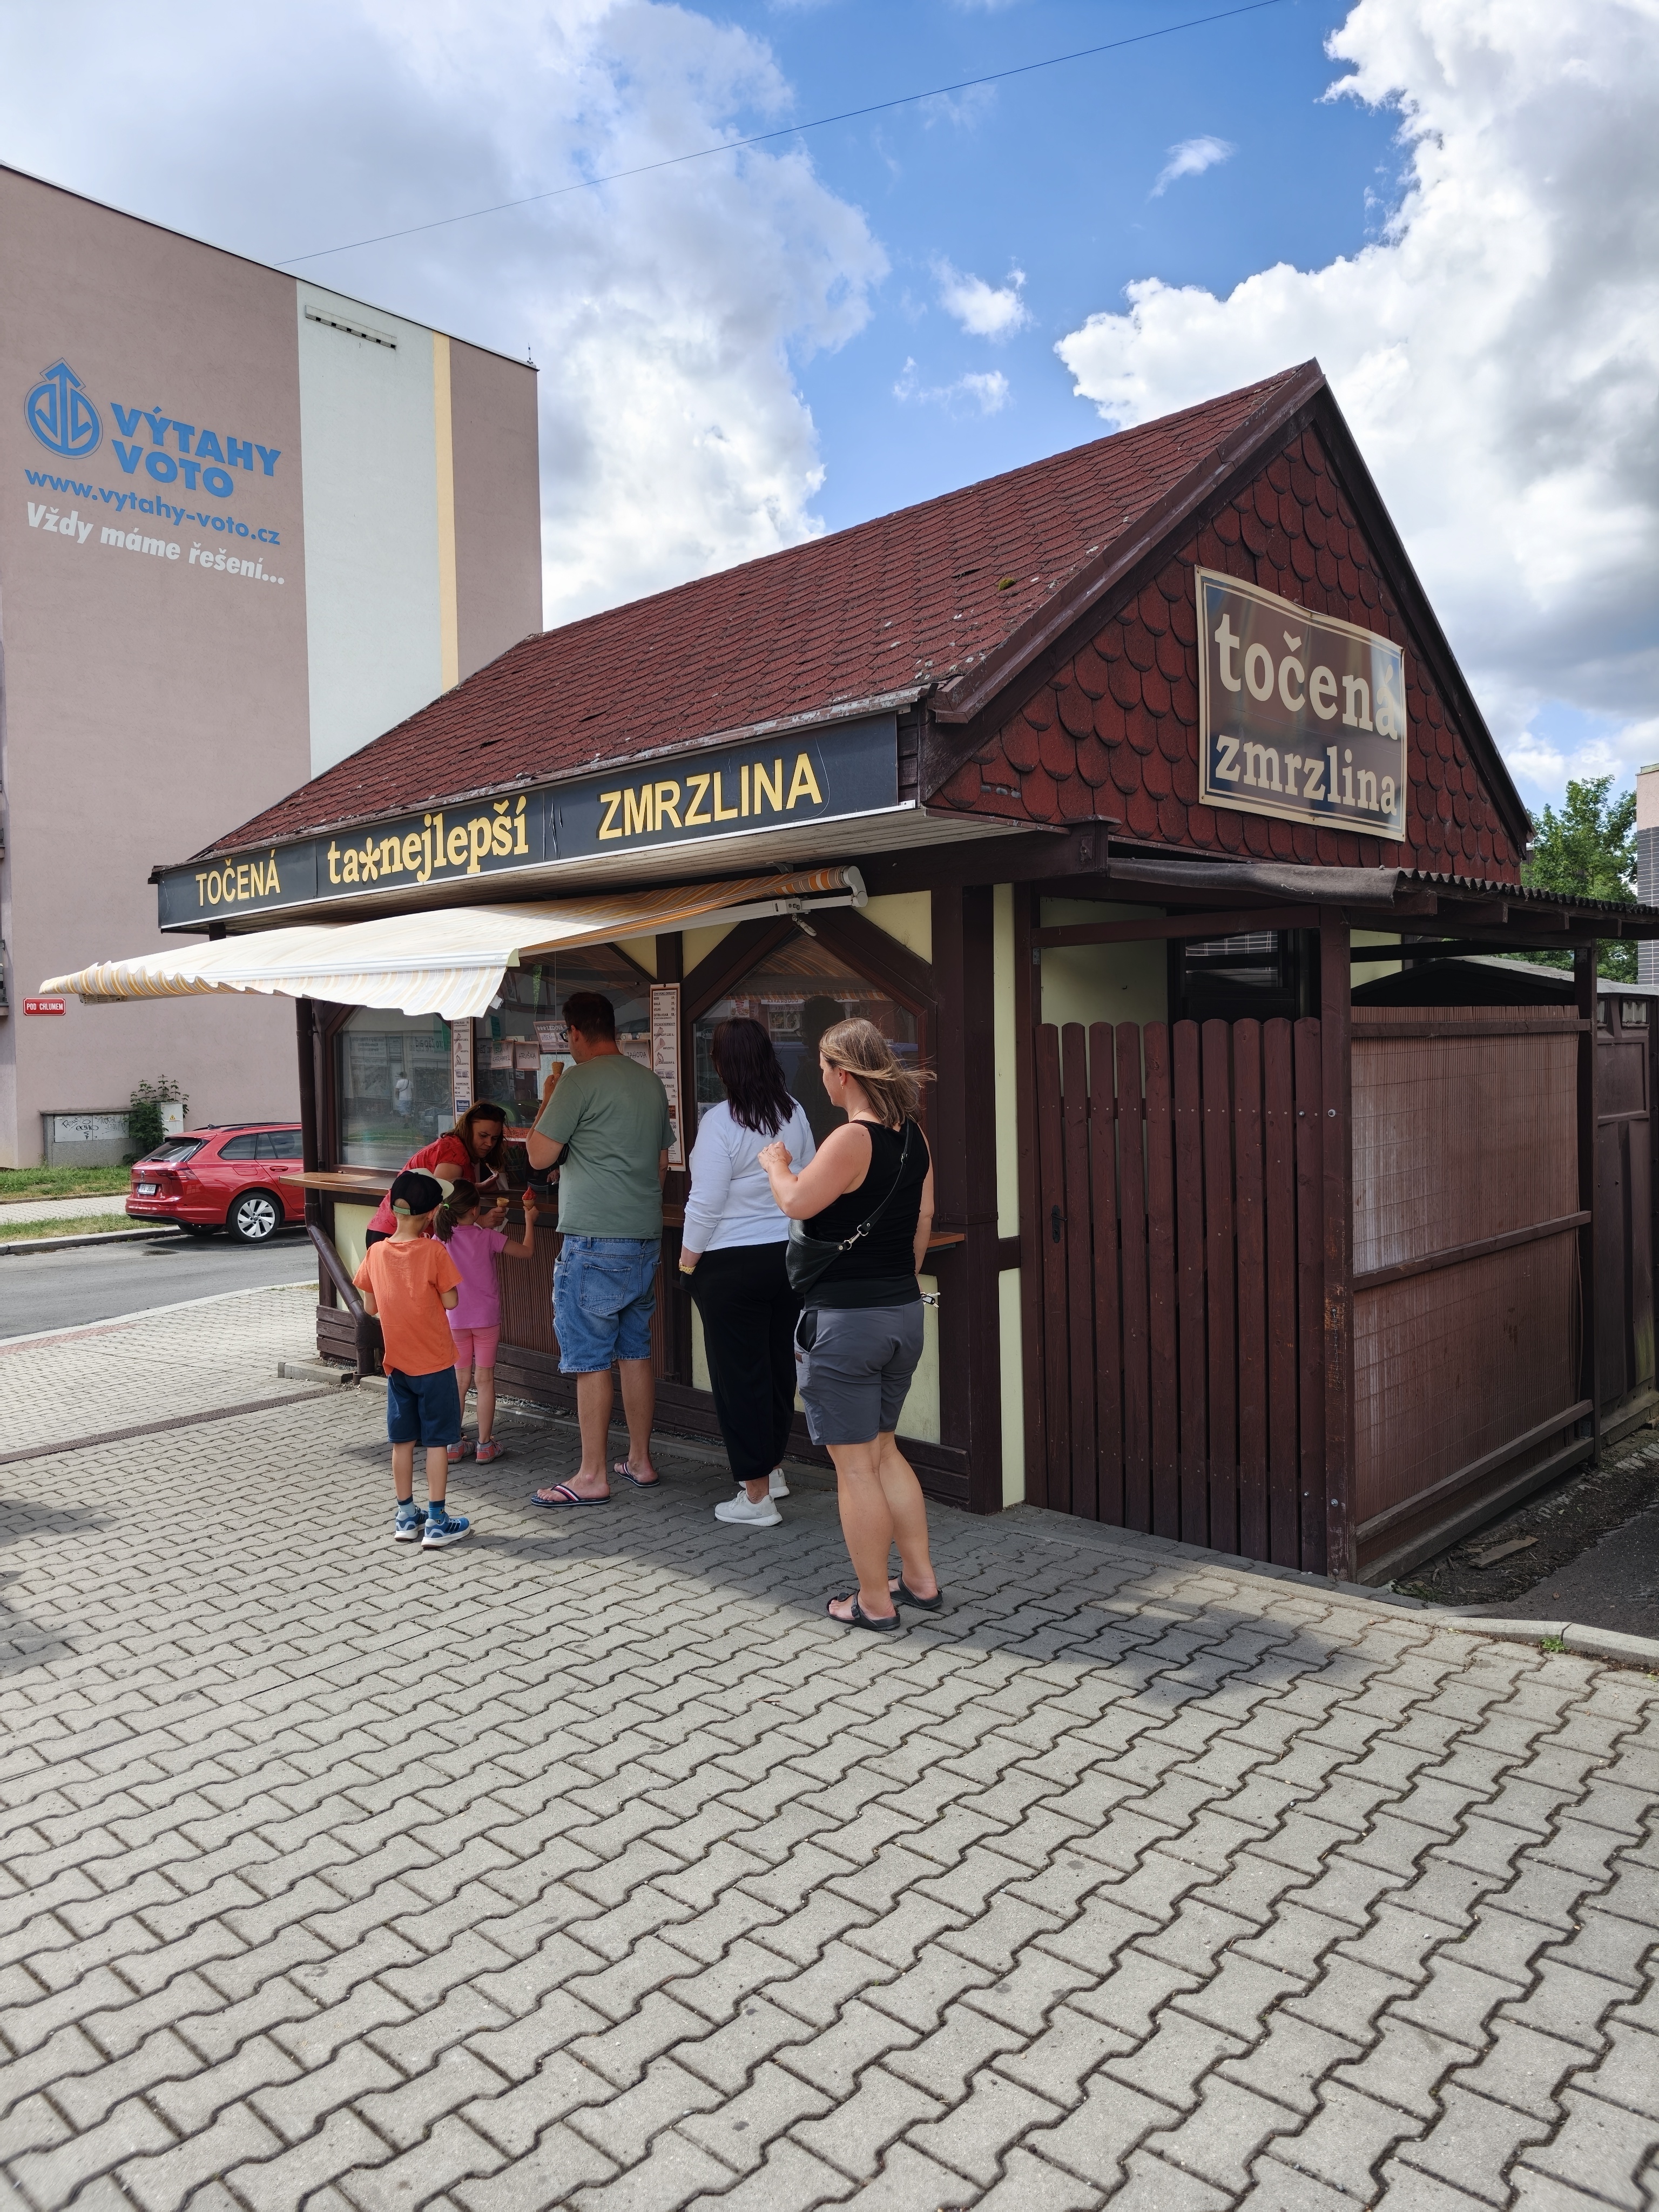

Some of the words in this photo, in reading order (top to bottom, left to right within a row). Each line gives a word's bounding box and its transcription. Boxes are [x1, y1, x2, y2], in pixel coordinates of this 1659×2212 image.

[110, 402, 281, 477] VÝTAHY
[111, 439, 234, 498] VOTO
[24, 469, 280, 545] www.vytahy-voto.cz
[27, 502, 94, 544] Vždy
[100, 528, 180, 560] máme
[188, 542, 285, 585] řešení...
[1215, 613, 1398, 740] točená
[1216, 734, 1397, 817] zmrzlina
[195, 849, 281, 906] TOČENÁ
[598, 753, 822, 841] ZMRZLINA
[519, 1051, 536, 1060] HRUŠKA
